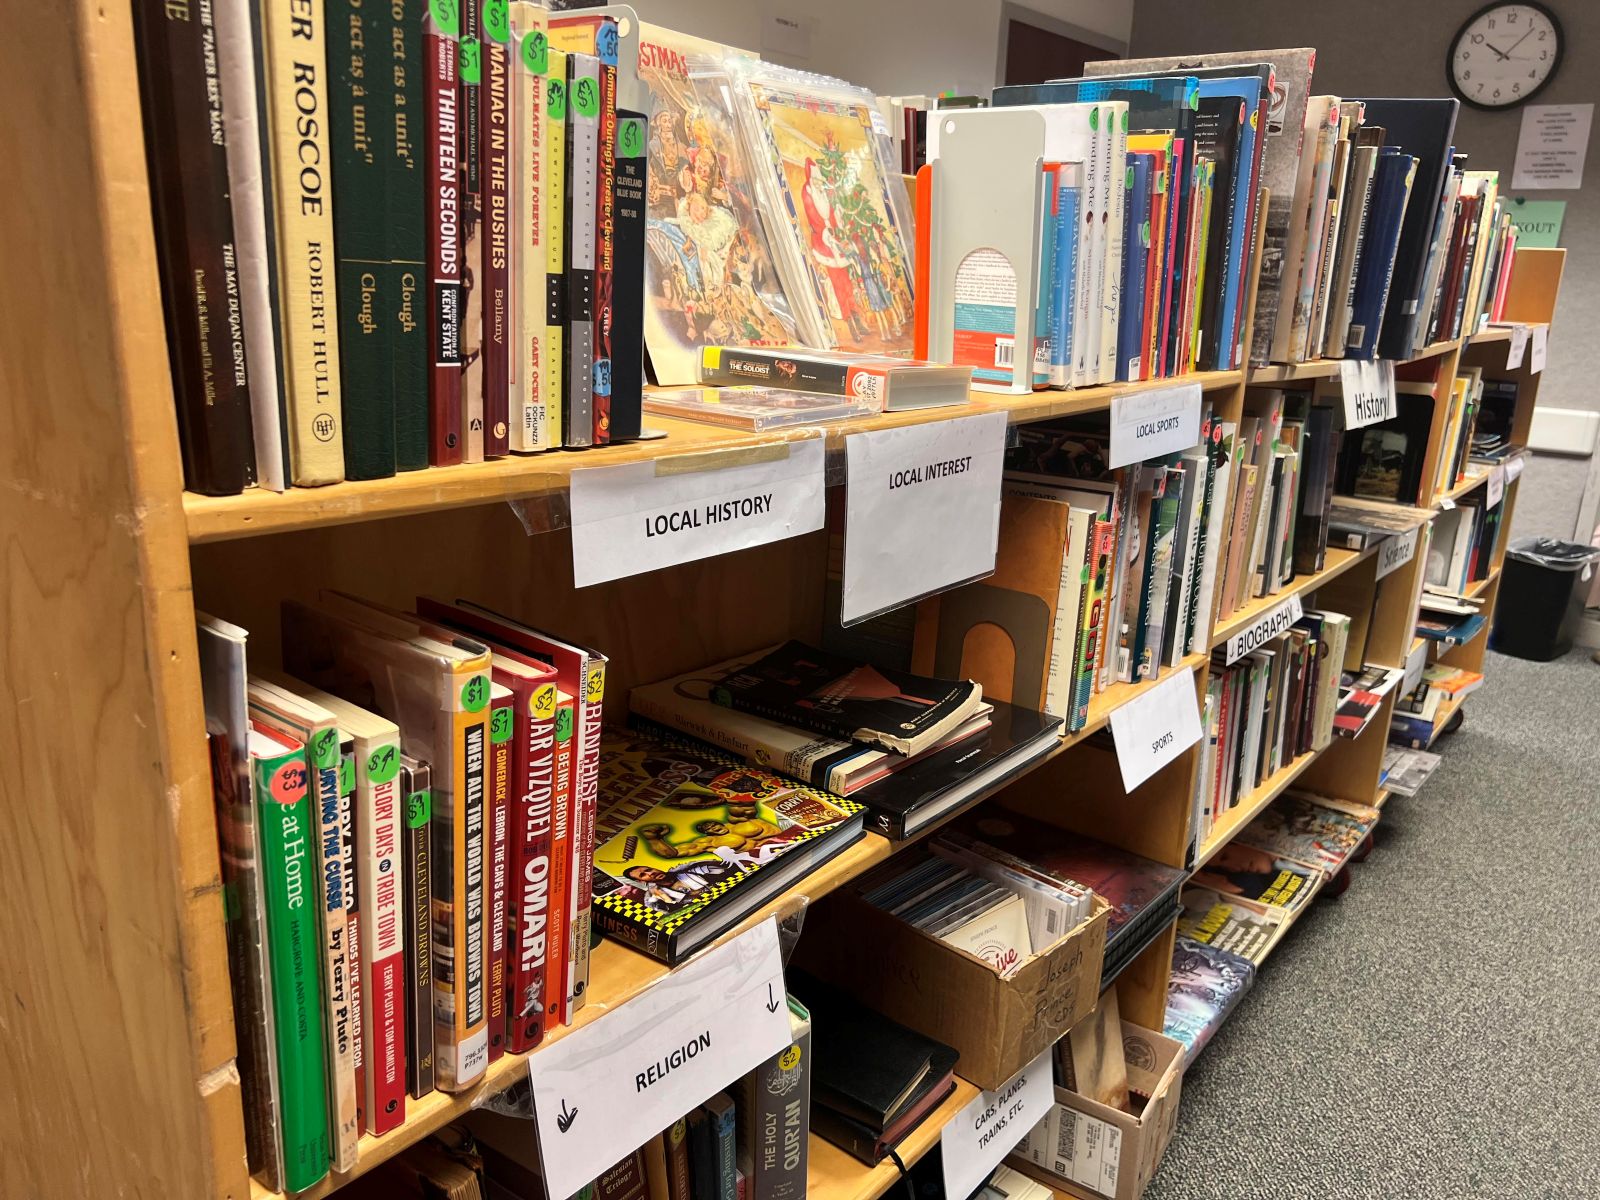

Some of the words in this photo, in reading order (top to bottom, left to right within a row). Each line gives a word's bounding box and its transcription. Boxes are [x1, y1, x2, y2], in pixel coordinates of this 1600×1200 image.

[391, 0, 406, 20] to
[490, 8, 507, 30] $1
[1488, 19, 1496, 29] 11
[1507, 13, 1518, 24] 12
[349, 14, 366, 50] act
[392, 27, 408, 59] act
[1471, 34, 1485, 45] 10
[1538, 30, 1546, 41] 2
[351, 55, 365, 78] as
[460, 48, 478, 69] $1
[1462, 51, 1470, 61] 9
[1539, 50, 1547, 61] 3
[353, 85, 365, 98] a
[395, 66, 407, 88] as
[490, 42, 506, 123] MANIAC
[1463, 70, 1471, 81] 8
[1477, 83, 1485, 93] 7
[1512, 82, 1520, 93] 5
[1528, 70, 1536, 79] 4
[395, 94, 407, 107] a
[605, 66, 616, 120] Romantic
[1493, 88, 1501, 99] 6
[294, 62, 323, 217] ROSCOE
[353, 105, 374, 164] unit"
[396, 113, 414, 168] unit"
[439, 88, 457, 181] THIRTEEN
[490, 129, 506, 150] IN
[604, 123, 614, 163] Outings
[490, 155, 506, 190] THE
[532, 152, 542, 181] LIVE
[616, 176, 643, 188] CLEVELAND
[625, 165, 636, 175] THE
[604, 178, 613, 218] Greater
[616, 188, 629, 198] BLUE
[440, 186, 457, 274] SECONDS
[490, 196, 506, 270] BUSHES
[532, 186, 542, 247] FOREVER
[223, 243, 236, 267] THE
[603, 220, 614, 271] Cleveland
[225, 269, 239, 295] MAY
[308, 241, 325, 335] ROBERT
[358, 273, 377, 335] Clough
[399, 273, 416, 333] Clough
[442, 289, 452, 321] KENT
[494, 289, 505, 344] Bellamy
[551, 279, 560, 321] 2002
[228, 297, 242, 340] DUGAN
[450, 289, 458, 346] CONFRONTATION
[442, 323, 453, 358] STATE
[531, 337, 540, 367] GARY
[232, 341, 246, 387] CENTER
[313, 341, 330, 404] HULL
[730, 363, 743, 371] THE
[743, 364, 771, 375] SOLOIST
[525, 406, 536, 428] Latin
[1355, 392, 1388, 421] History
[1136, 423, 1156, 439] LOCAL
[1157, 416, 1180, 433] SPORTS
[889, 468, 923, 490] LOCAL
[925, 456, 972, 482] INTEREST
[646, 508, 702, 538] LOCAL
[706, 493, 773, 525] HISTORY
[1196, 533, 1208, 574] TIGER
[1189, 575, 1203, 627] WOODS
[1236, 603, 1294, 657] BIOGRAPHY
[467, 686, 483, 705] $1
[580, 661, 589, 705] SCHNEIDER
[587, 680, 604, 695] $2
[535, 693, 553, 711] $2
[490, 718, 508, 733] $1
[556, 719, 571, 733] $1
[1151, 731, 1174, 754] SPORTS
[466, 728, 483, 771] WHEN
[282, 768, 299, 792] $3
[466, 774, 483, 802] ALL
[495, 749, 507, 805] COMEBACK:
[556, 753, 571, 791] BEING
[319, 768, 340, 824] URYING
[375, 781, 395, 821] GLORY
[521, 753, 553, 842] VIZQUEL
[775, 792, 810, 813] CORRY'S
[283, 811, 299, 834] at
[466, 804, 483, 835] THE
[495, 806, 506, 845] LEBRON,
[555, 795, 569, 841] BROWN
[586, 809, 596, 847] LEBRON
[322, 825, 342, 859] THE
[377, 823, 395, 858] DAYS
[494, 845, 505, 863] THE
[284, 840, 306, 910] Home
[381, 862, 391, 871] IN
[466, 837, 483, 889] WORLD
[494, 864, 505, 890] CAVS
[584, 849, 593, 883] JAMES
[323, 860, 345, 912] CURSE
[377, 872, 397, 912] TRIBE
[416, 852, 429, 929] CLEVELAND
[466, 889, 483, 922] WAS
[521, 855, 550, 973] OMAR!
[552, 909, 562, 932] SCOTT
[329, 930, 345, 950] by
[347, 918, 360, 958] THINGS
[378, 913, 400, 951] TOWN
[492, 901, 504, 952] CLEVELAND
[289, 919, 304, 978] HARGROVE
[419, 932, 430, 988] BROWNS
[467, 922, 483, 981] BROWNS
[551, 934, 561, 959] HULER
[331, 953, 348, 1001] Terry
[350, 961, 361, 984] I'VE
[383, 962, 393, 990] TERRY
[492, 958, 504, 987] TERRY
[295, 979, 306, 1004] AND
[383, 991, 394, 1018] PLUTO
[467, 981, 483, 1024] TOWN
[491, 988, 502, 1019] PLUTO
[297, 1005, 309, 1042] COSTA
[351, 986, 363, 1035] LEARNED
[335, 1004, 351, 1054] Pluto
[385, 1027, 395, 1045] TOM
[353, 1037, 364, 1068] FROM
[385, 1046, 397, 1084] HAMILTON
[634, 1030, 712, 1093] RELIGION
[782, 1052, 797, 1068] $2
[975, 1104, 999, 1131] CARS,
[998, 1075, 1028, 1110] PLANES,
[765, 1112, 777, 1144] HOLY
[783, 1098, 801, 1171] QUR'AN
[978, 1115, 1009, 1150] TRAINS,
[1009, 1099, 1025, 1121] ETC.
[764, 1146, 777, 1170] THE
